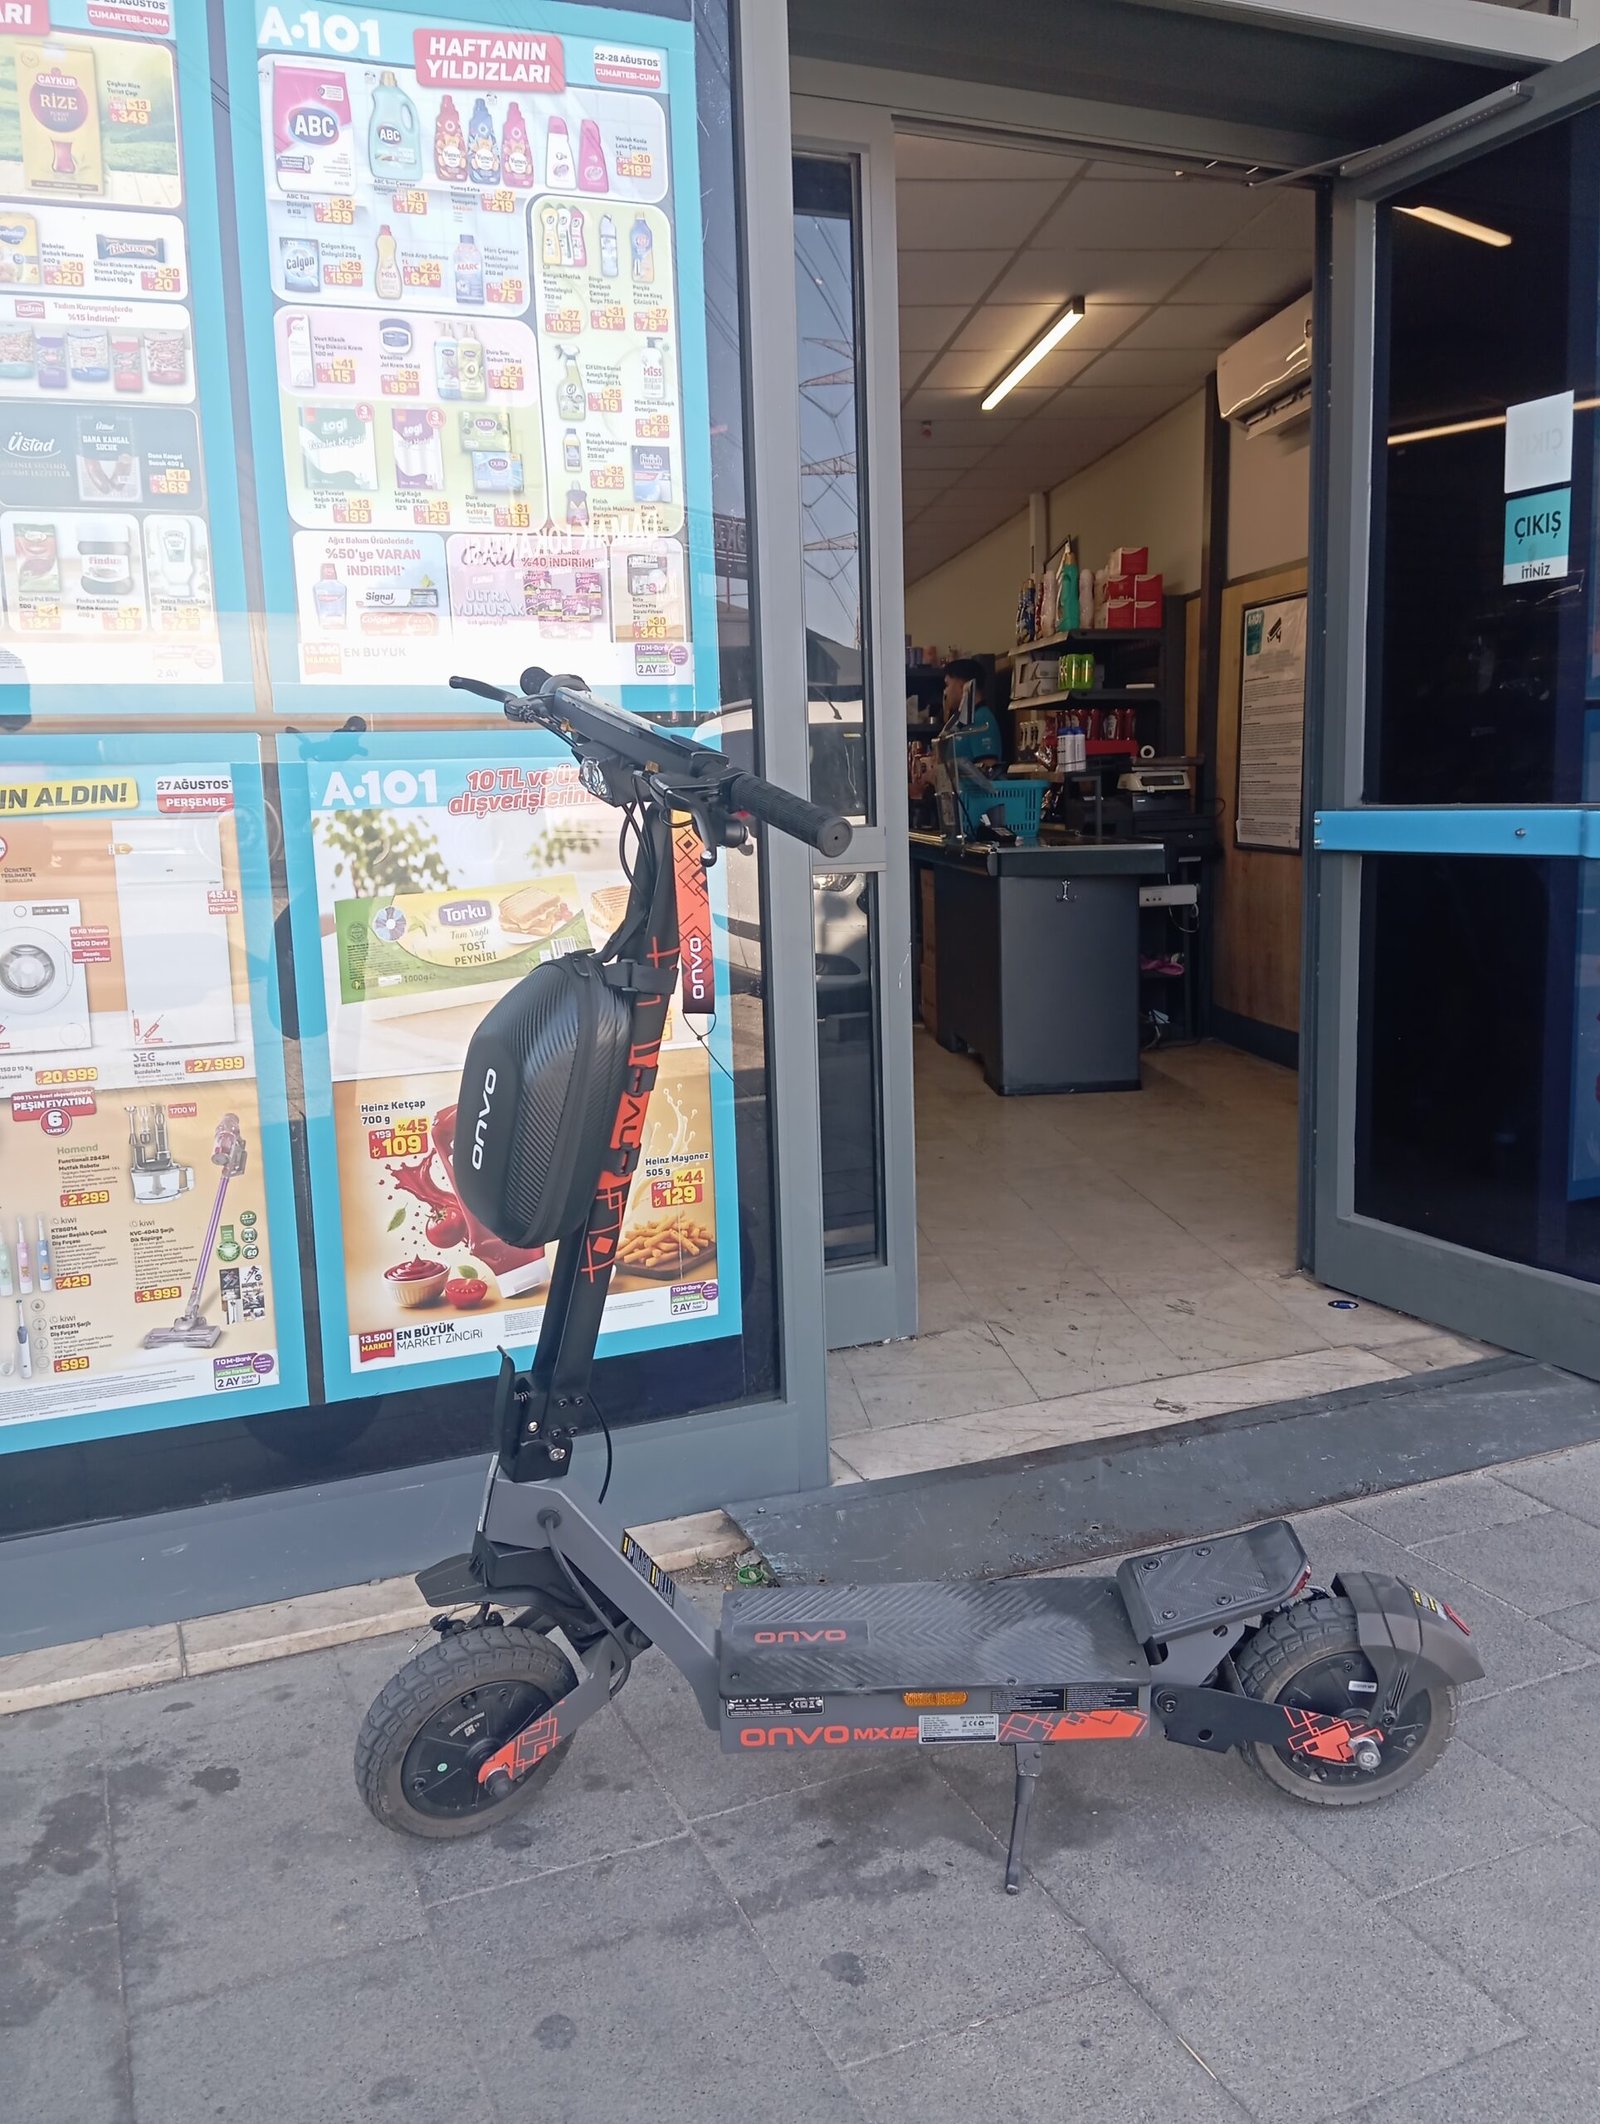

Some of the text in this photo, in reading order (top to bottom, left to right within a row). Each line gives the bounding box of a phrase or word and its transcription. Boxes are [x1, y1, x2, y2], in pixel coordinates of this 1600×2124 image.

[429, 36, 547, 62] HAFTANIN
[426, 59, 550, 84] YILDIZLARI
[294, 114, 335, 138] ABC
[379, 128, 401, 142] ABC
[1514, 509, 1562, 545] ÇIKIŞ
[377, 548, 421, 560] VARAN
[1521, 562, 1551, 580] İTİNİZ
[157, 780, 171, 791] 27
[467, 769, 495, 792] 10
[497, 767, 526, 790] TL
[527, 769, 554, 788] ve
[34, 782, 127, 807] ALDIN!
[442, 903, 487, 923] Torku
[460, 940, 487, 953] TOST
[361, 1100, 426, 1113] Heinz Ketçap
[48, 1111, 63, 1128] 6
[361, 1115, 382, 1125] 700
[645, 1151, 709, 1167] Heinz Mayonez
[645, 1167, 665, 1178] 505
[680, 1302, 692, 1312] AY
[360, 1332, 393, 1343] 13.500
[396, 1322, 455, 1341] EN BÜYÜK
[361, 1341, 393, 1353] MARKET
[396, 1336, 445, 1351] MARKET
[226, 1376, 240, 1387] AY
